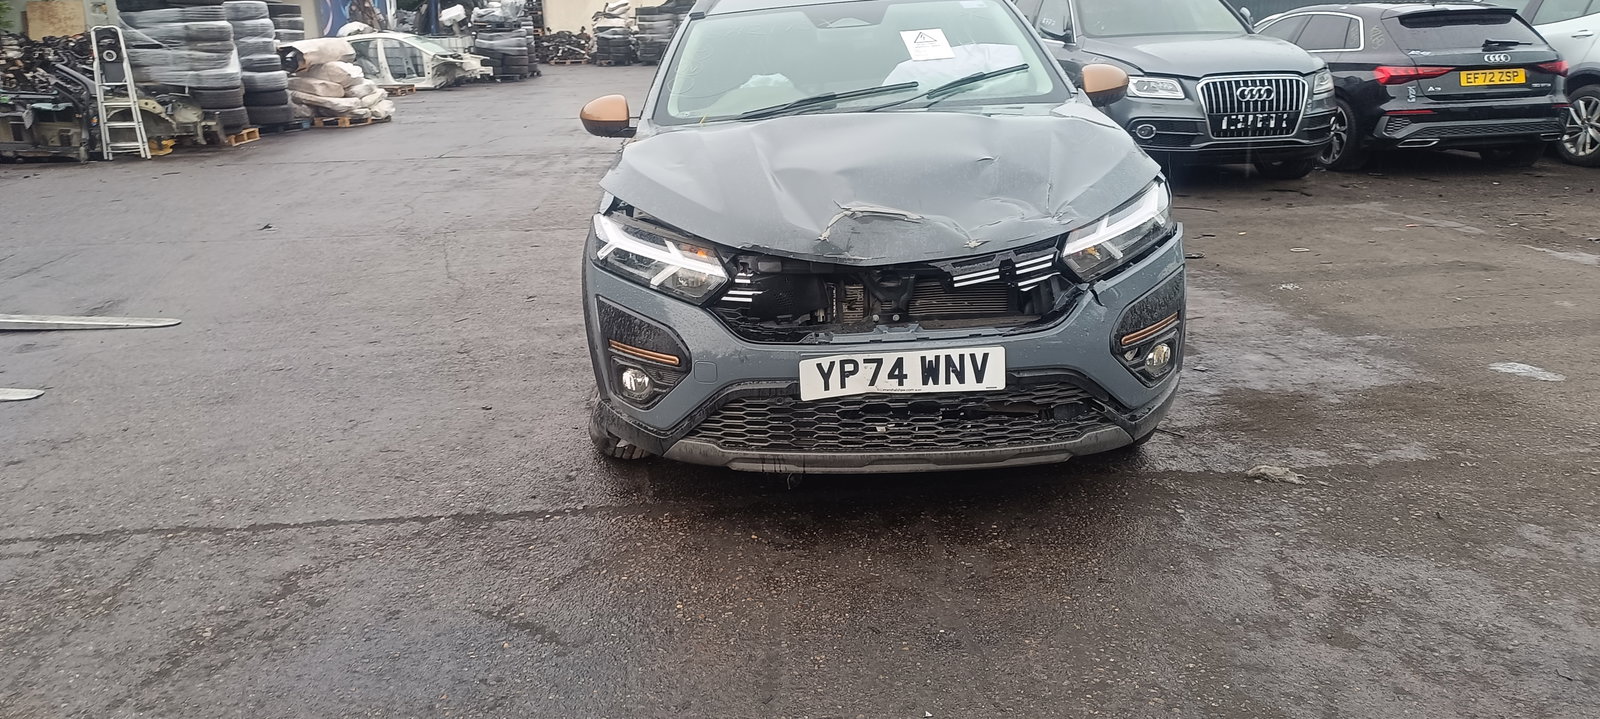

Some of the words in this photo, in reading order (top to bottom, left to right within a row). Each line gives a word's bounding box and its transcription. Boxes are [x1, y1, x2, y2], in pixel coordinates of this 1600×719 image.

[1466, 72, 1495, 84] EF72
[1498, 71, 1519, 82] ZSP
[816, 357, 908, 391] YP74
[920, 353, 990, 385] WNV
